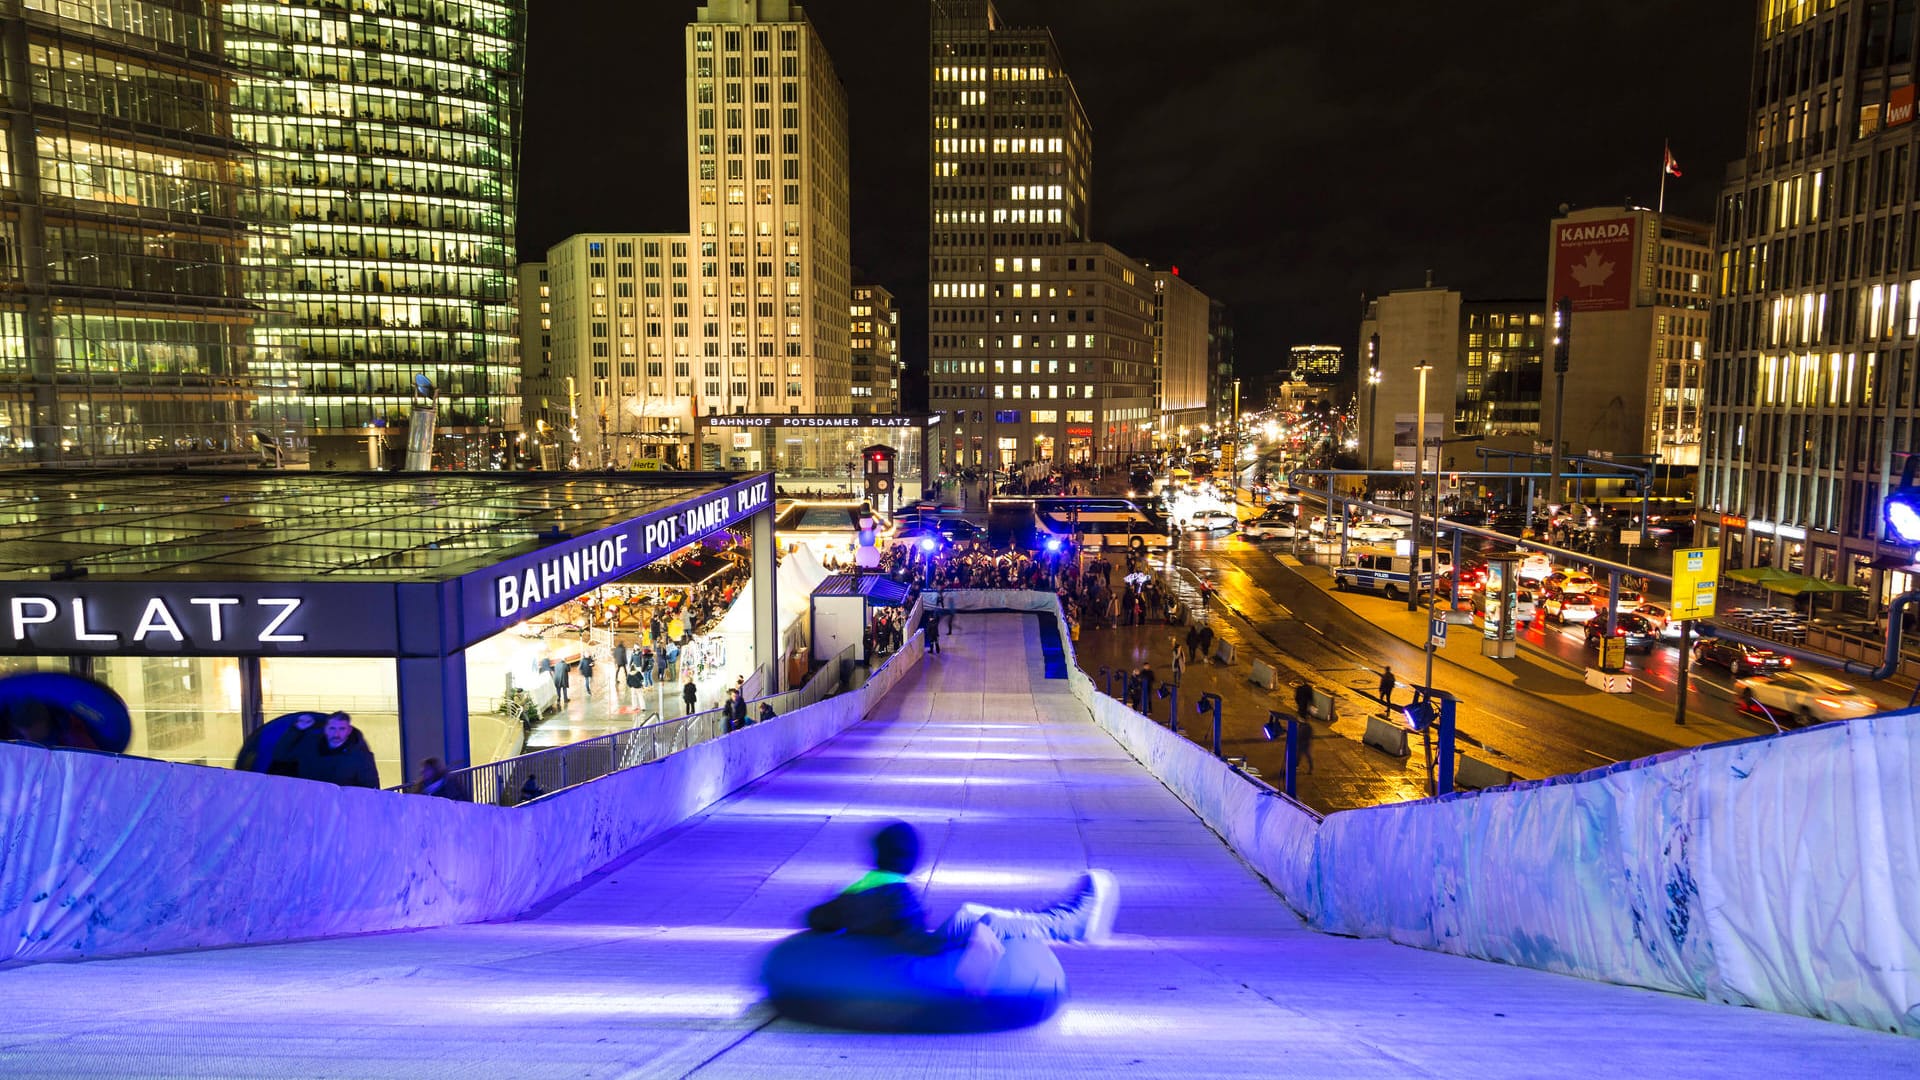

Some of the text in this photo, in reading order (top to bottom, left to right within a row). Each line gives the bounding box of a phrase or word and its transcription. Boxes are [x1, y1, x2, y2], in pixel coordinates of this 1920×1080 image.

[1561, 223, 1630, 241] KANADA
[710, 418, 911, 426] BAHNHOF POTSDAMER PLATZ
[633, 461, 655, 469] Hertz
[499, 534, 628, 618] BAHNHOF
[738, 482, 767, 513] PLATZ
[11, 597, 304, 641] PLATZ
[1435, 620, 1445, 636] U
